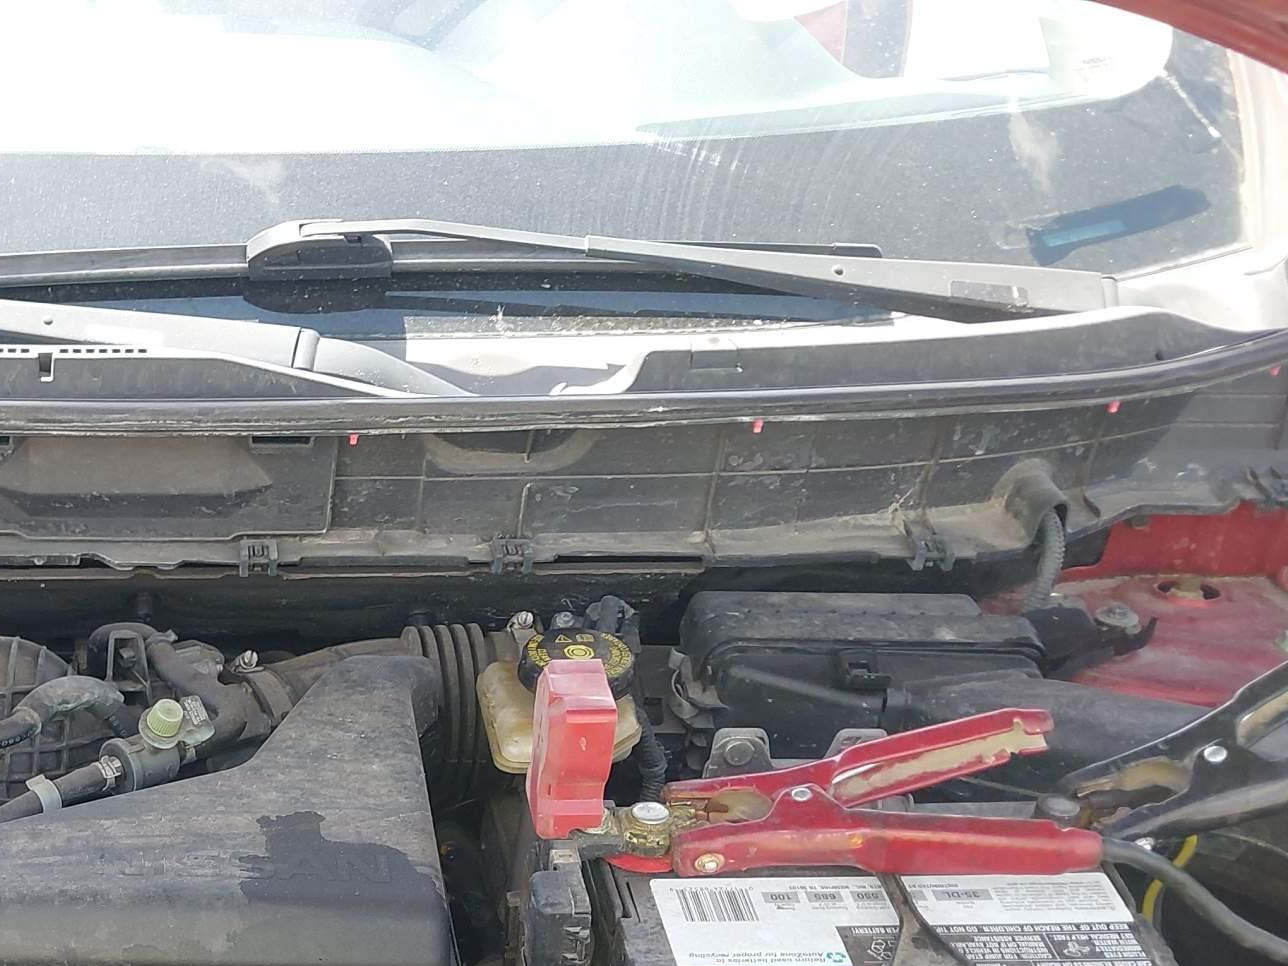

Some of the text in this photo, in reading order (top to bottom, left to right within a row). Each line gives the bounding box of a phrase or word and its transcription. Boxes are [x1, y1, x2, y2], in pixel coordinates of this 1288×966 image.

[770, 893, 792, 901] 100
[1079, 923, 1090, 931] OF
[1091, 923, 1107, 931] OUT
[1108, 923, 1129, 931] KEEP
[688, 951, 729, 959] recycling
[732, 951, 762, 959] proper
